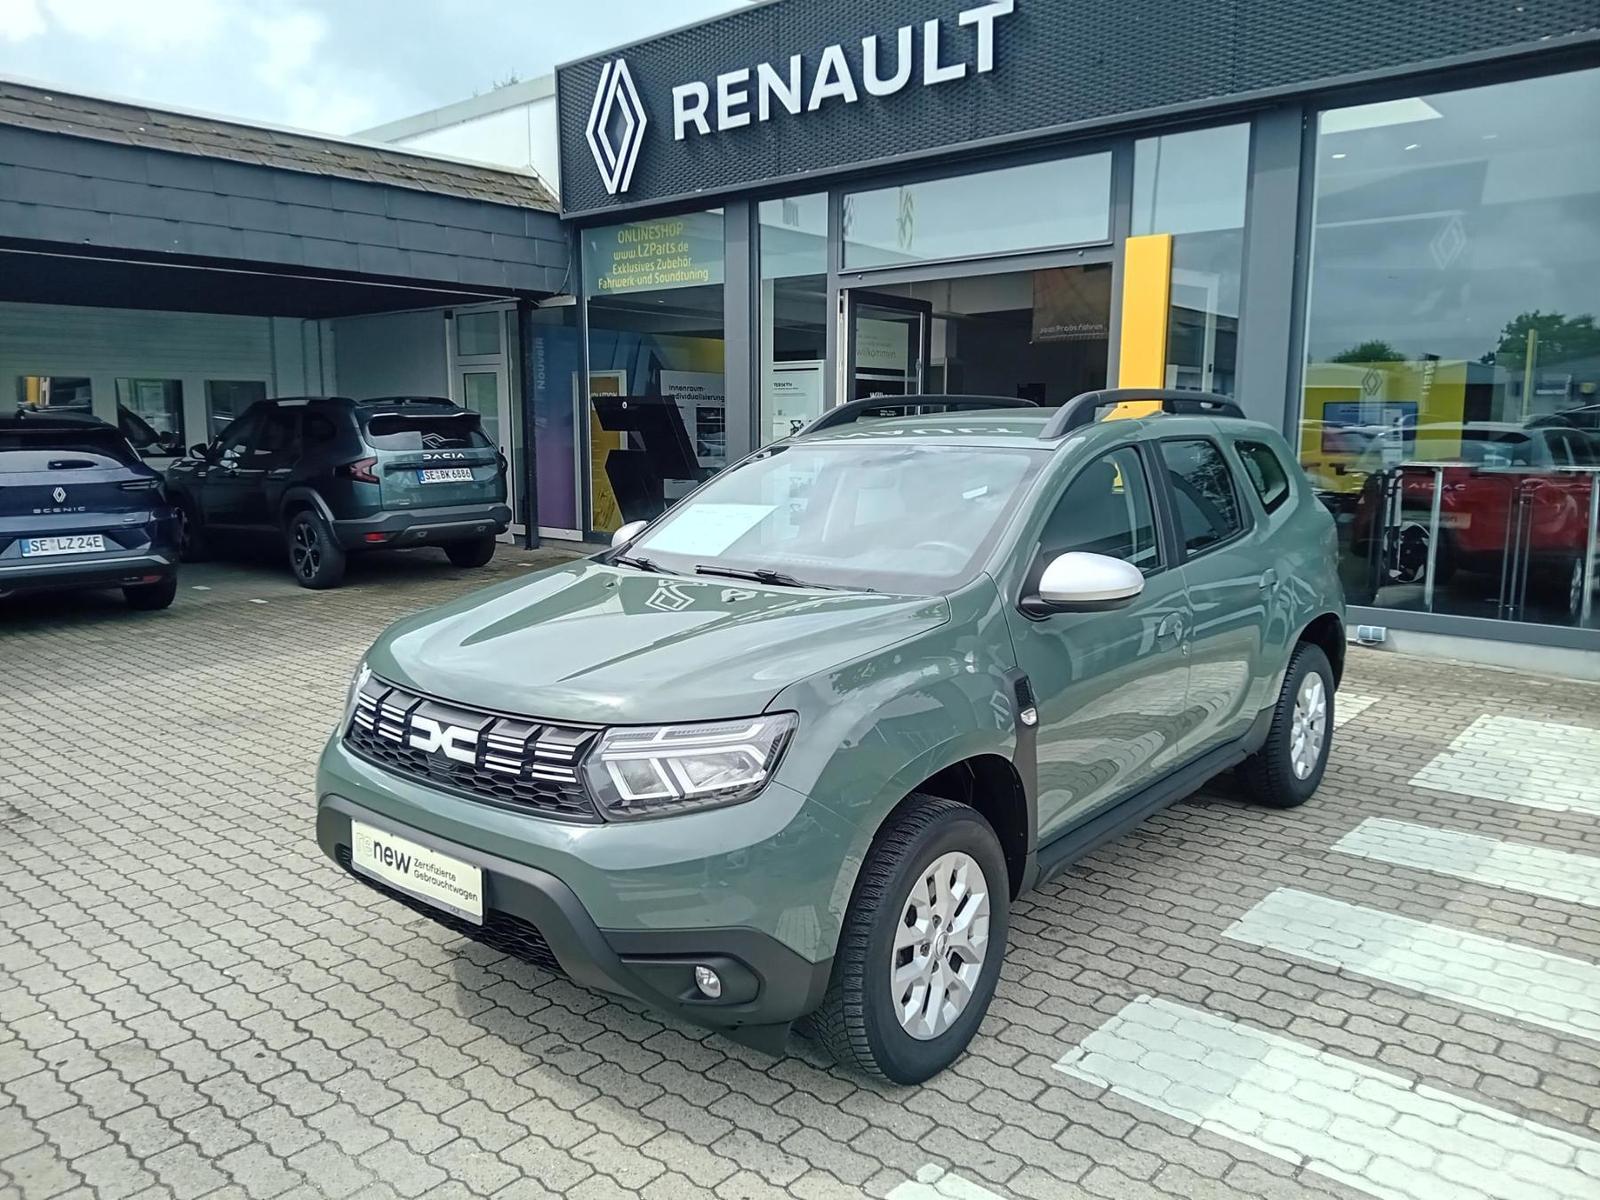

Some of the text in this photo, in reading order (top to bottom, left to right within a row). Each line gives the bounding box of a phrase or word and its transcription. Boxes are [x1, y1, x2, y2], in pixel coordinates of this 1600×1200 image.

[672, 0, 1015, 141] RENAULT
[617, 222, 684, 244] ONLINESHOP
[613, 241, 689, 261] www.LZParts.de
[612, 256, 693, 275] Exklusives Zubehör
[637, 273, 653, 285] und
[654, 269, 709, 284] Soundtuning
[425, 470, 436, 480] SE
[33, 506, 86, 514] SCENIC
[30, 535, 102, 553] SE LZ 24E
[413, 857, 457, 883] Zertifizierte
[413, 869, 479, 902] Gebrauchtwagen
